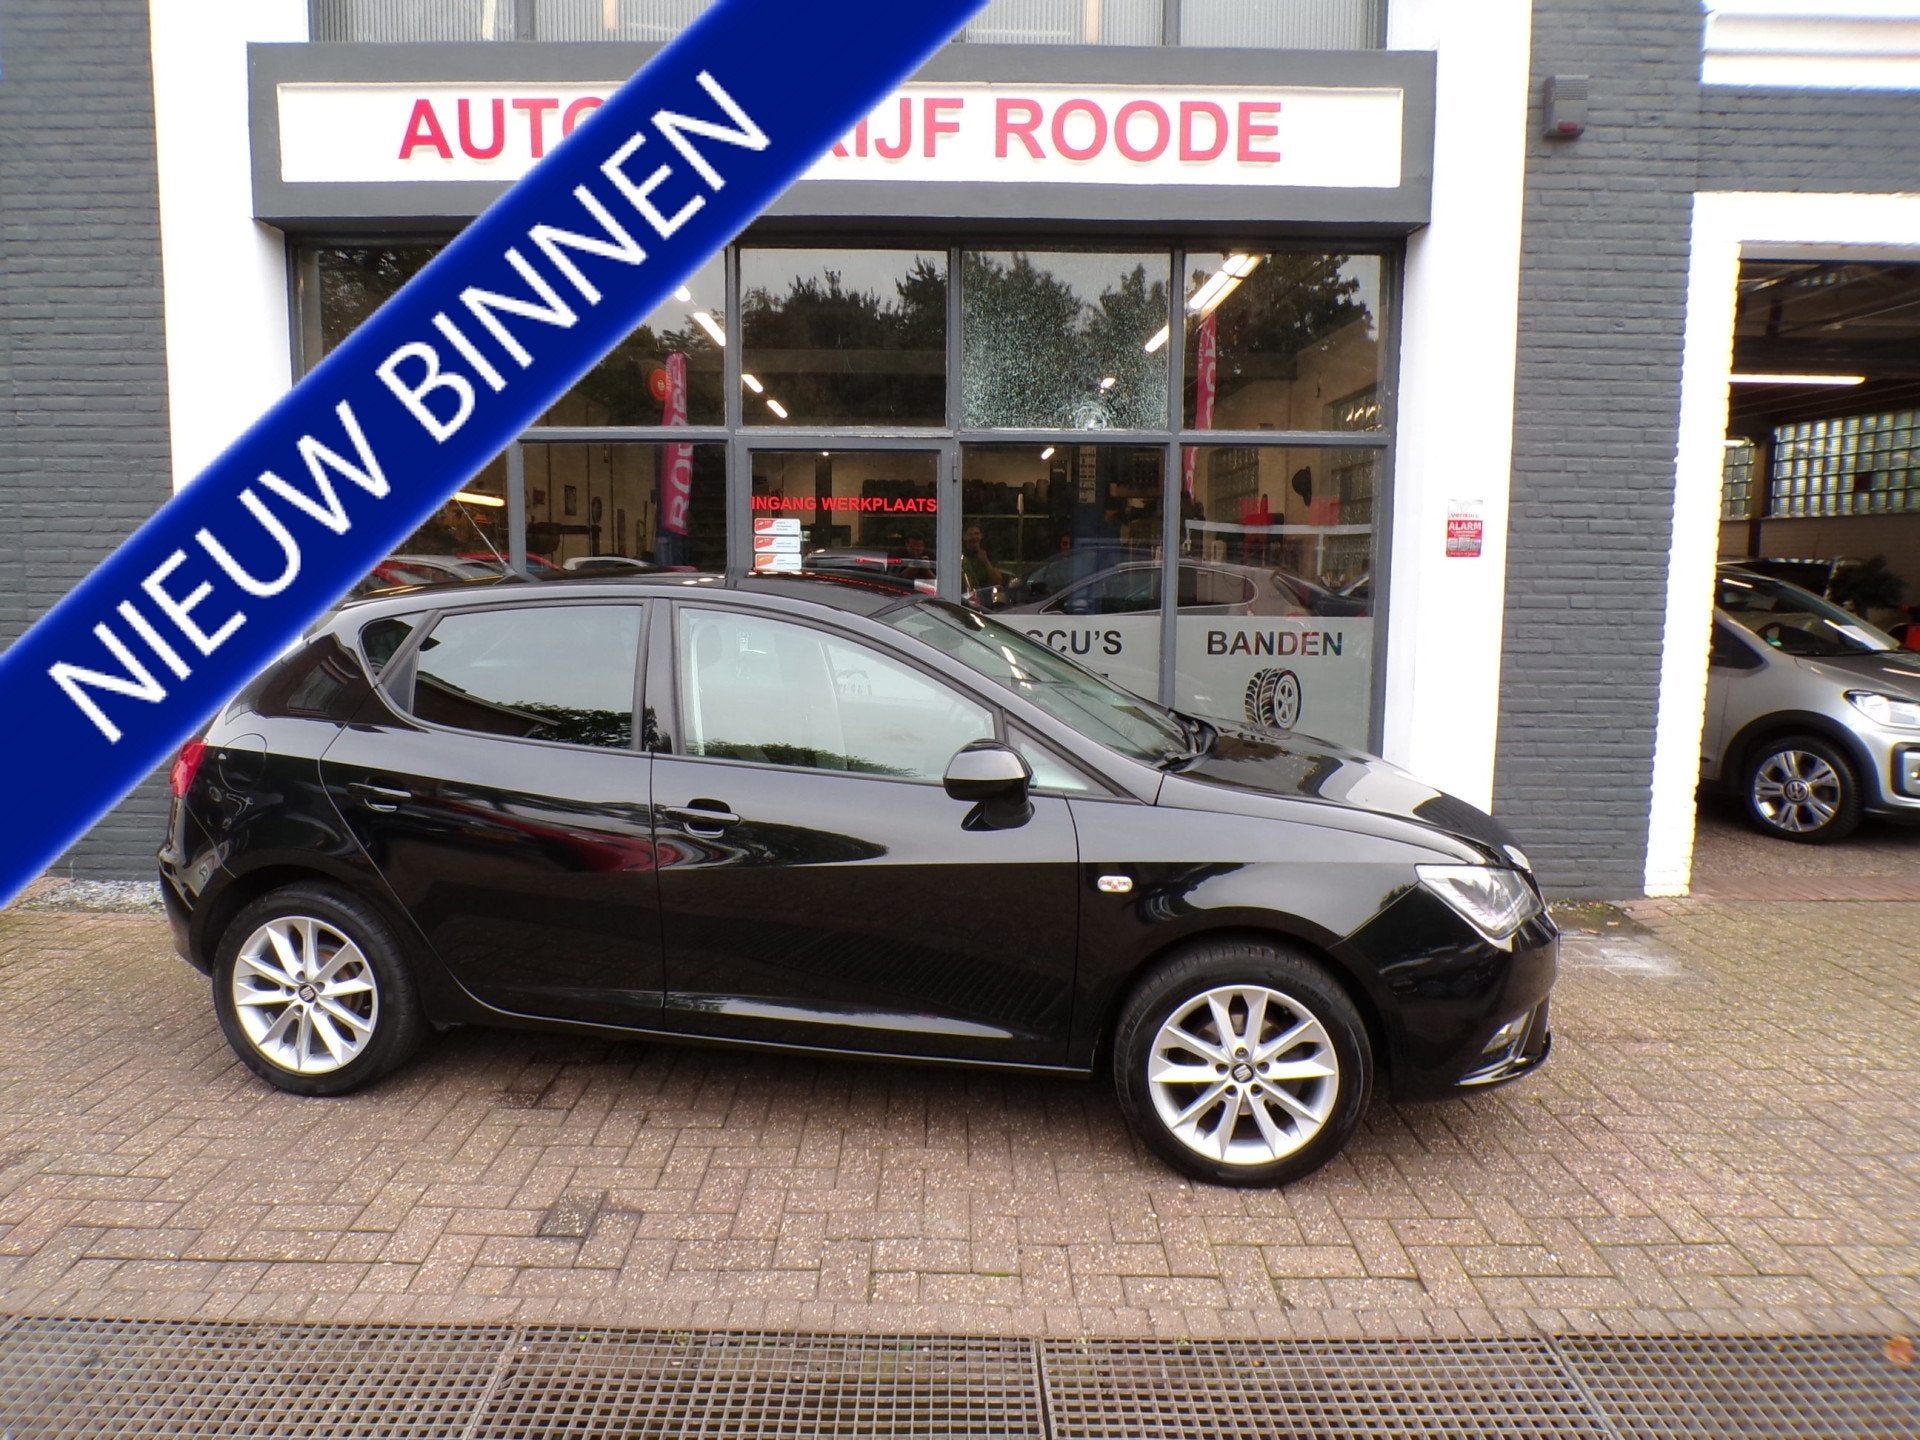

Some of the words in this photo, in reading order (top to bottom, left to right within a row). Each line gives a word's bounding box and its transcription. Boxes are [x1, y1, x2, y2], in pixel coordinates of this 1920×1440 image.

[994, 98, 1281, 162] ROODE
[751, 496, 817, 511] INGANG
[821, 497, 938, 513] WERKPLAATS
[1448, 521, 1482, 531] ALARM
[1207, 630, 1343, 657] BANDEN
